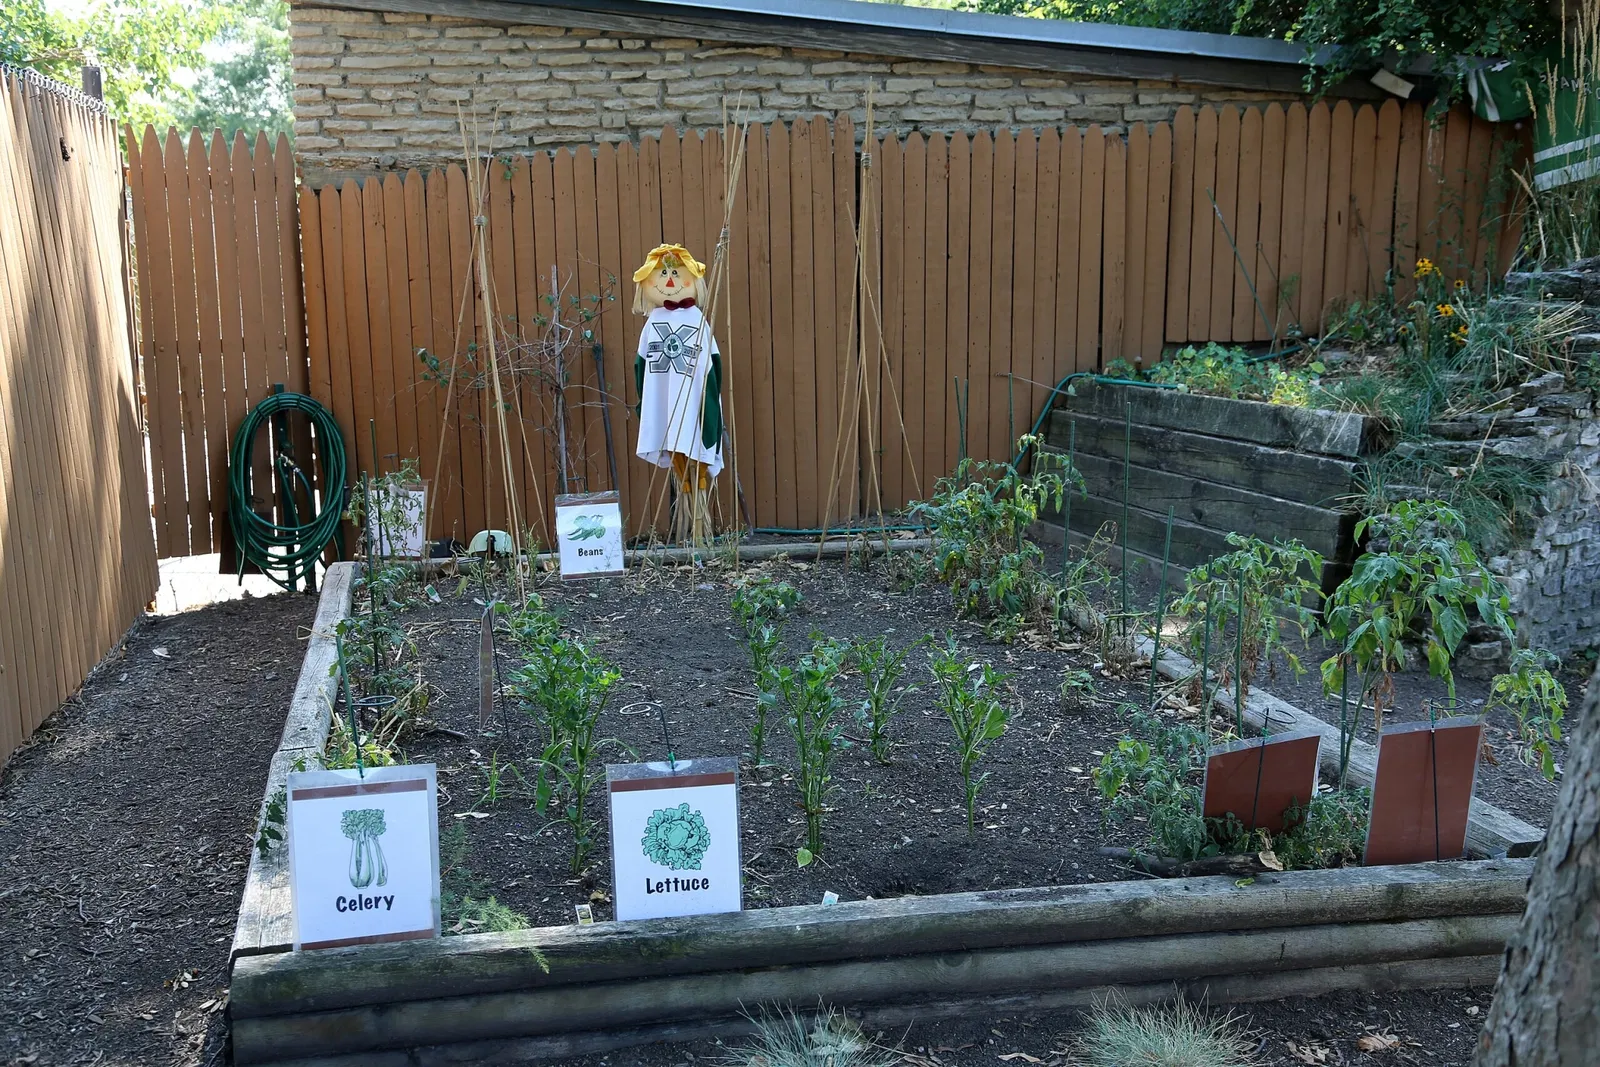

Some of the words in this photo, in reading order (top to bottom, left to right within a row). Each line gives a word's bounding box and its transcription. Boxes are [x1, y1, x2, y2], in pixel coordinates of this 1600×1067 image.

[578, 548, 604, 556] Beans
[646, 878, 709, 894] Lettuce
[336, 894, 394, 912] Celery
